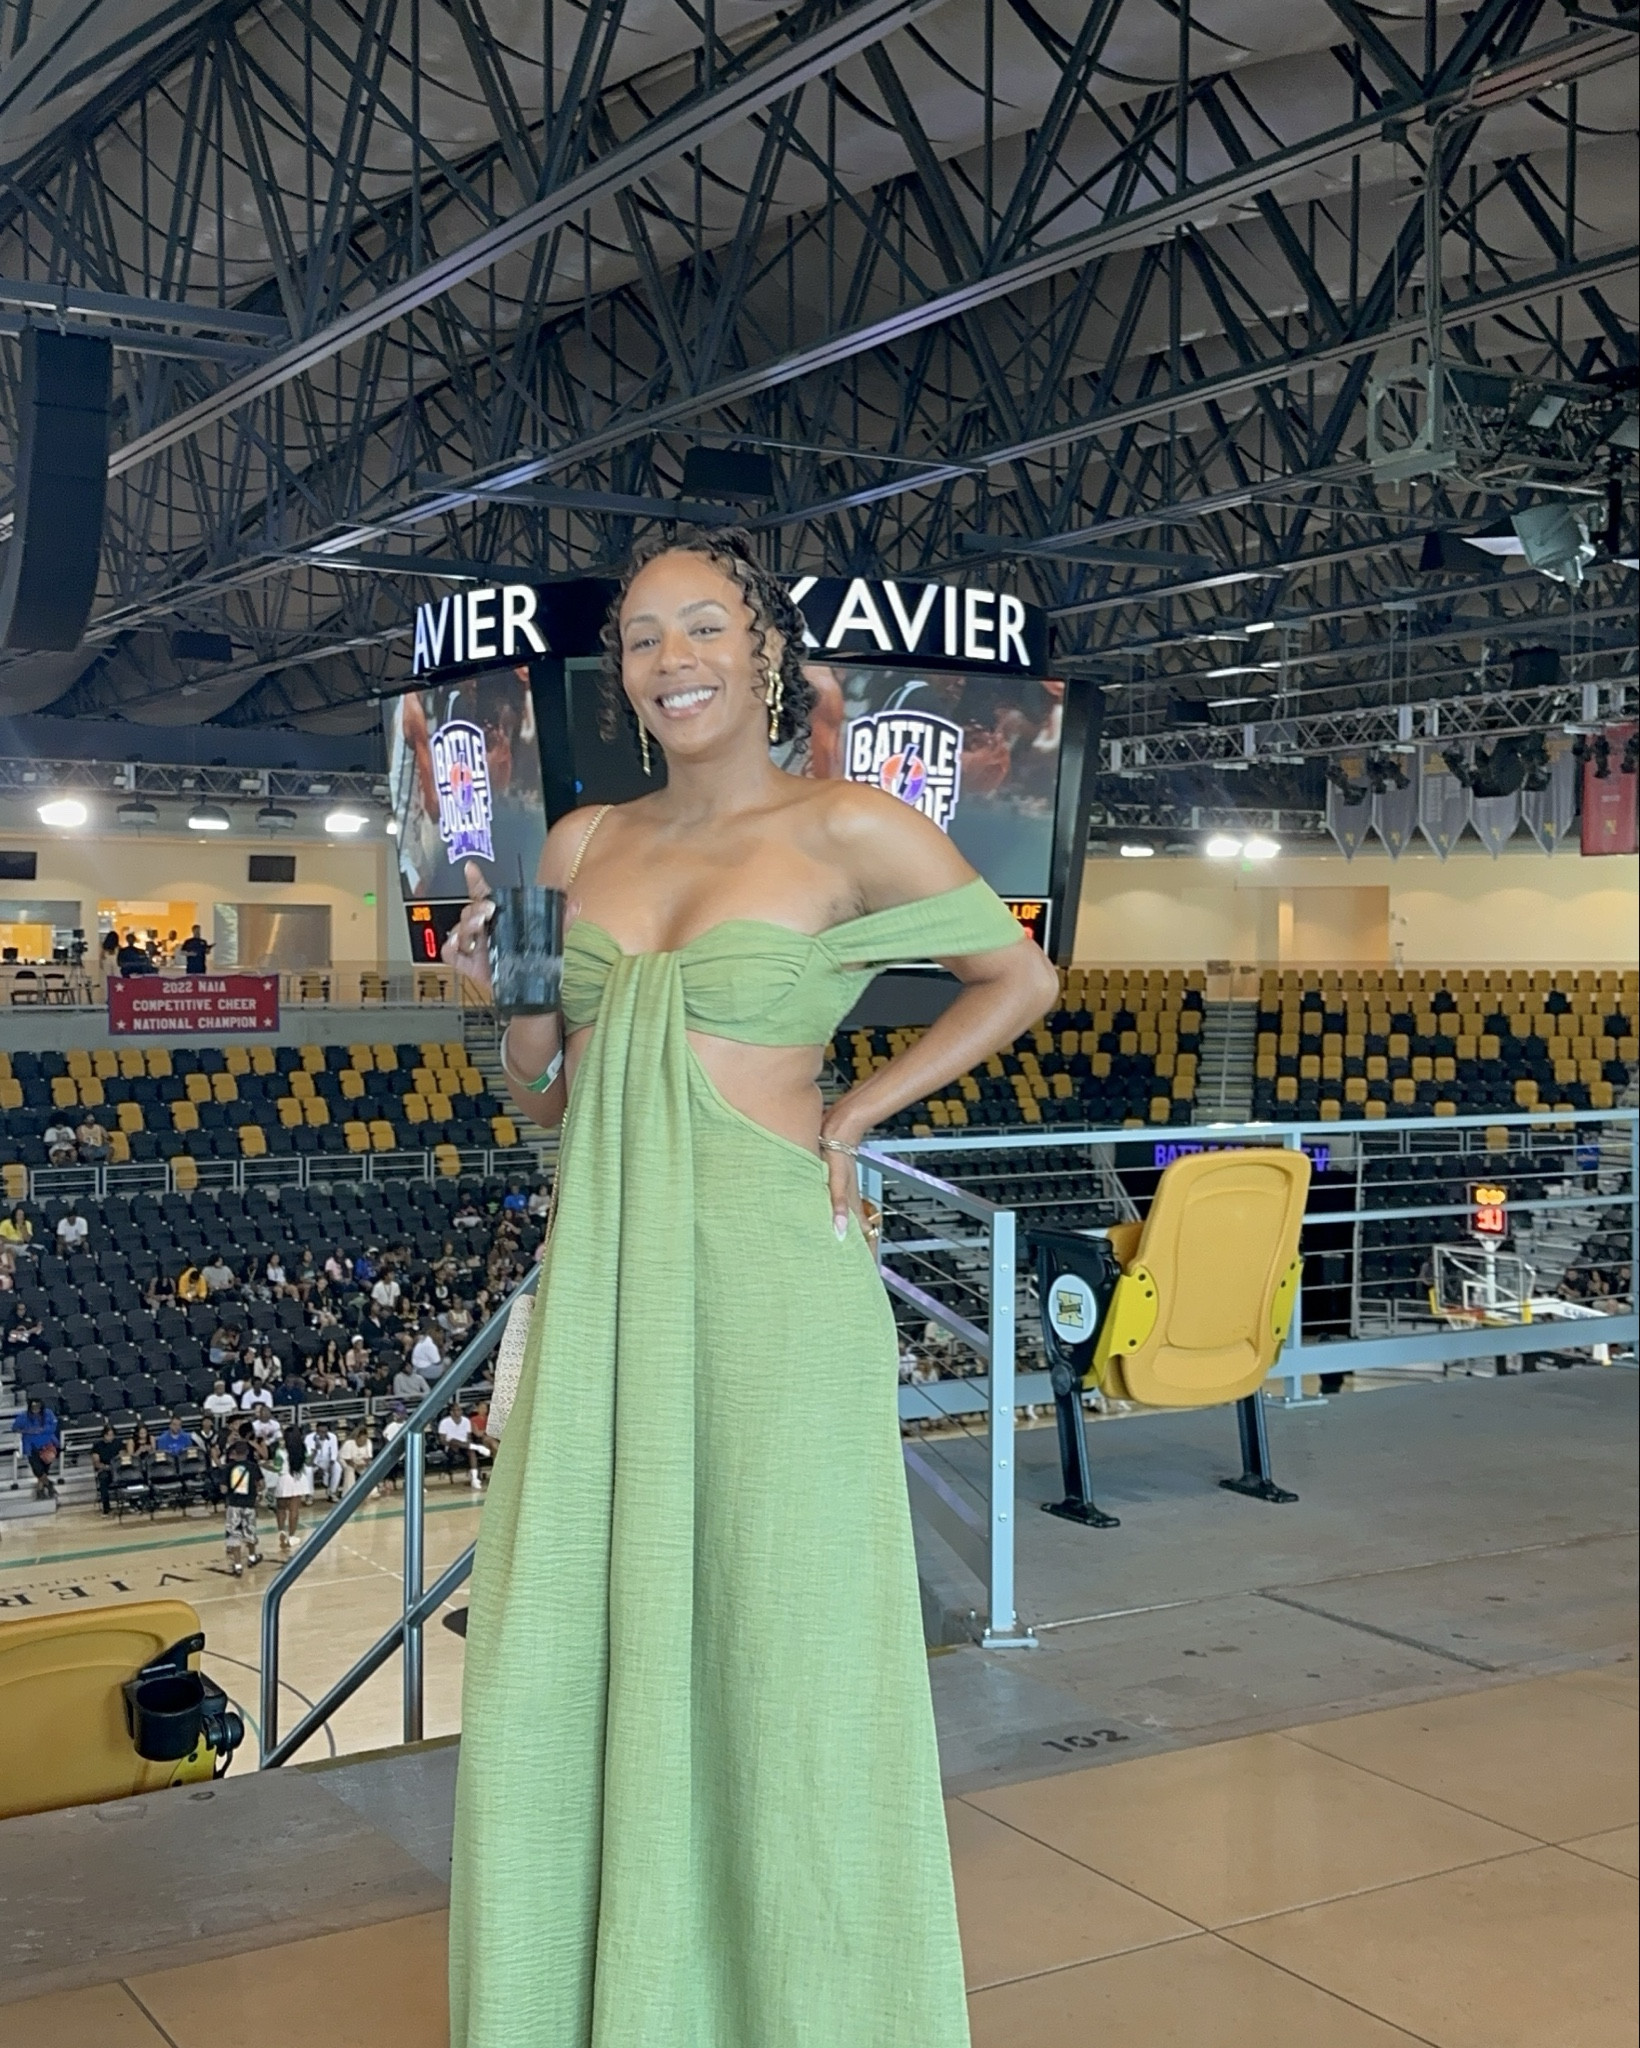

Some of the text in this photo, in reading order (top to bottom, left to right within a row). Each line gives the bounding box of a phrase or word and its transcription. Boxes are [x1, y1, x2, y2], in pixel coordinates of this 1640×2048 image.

[852, 720, 957, 776] BATTLE
[162, 981, 227, 994] 2022 NAIA
[132, 998, 257, 1012] COMPETITIVE CHEER
[133, 1016, 257, 1031] NATIONAL CHAMPION
[1041, 1728, 1130, 1753] 102
